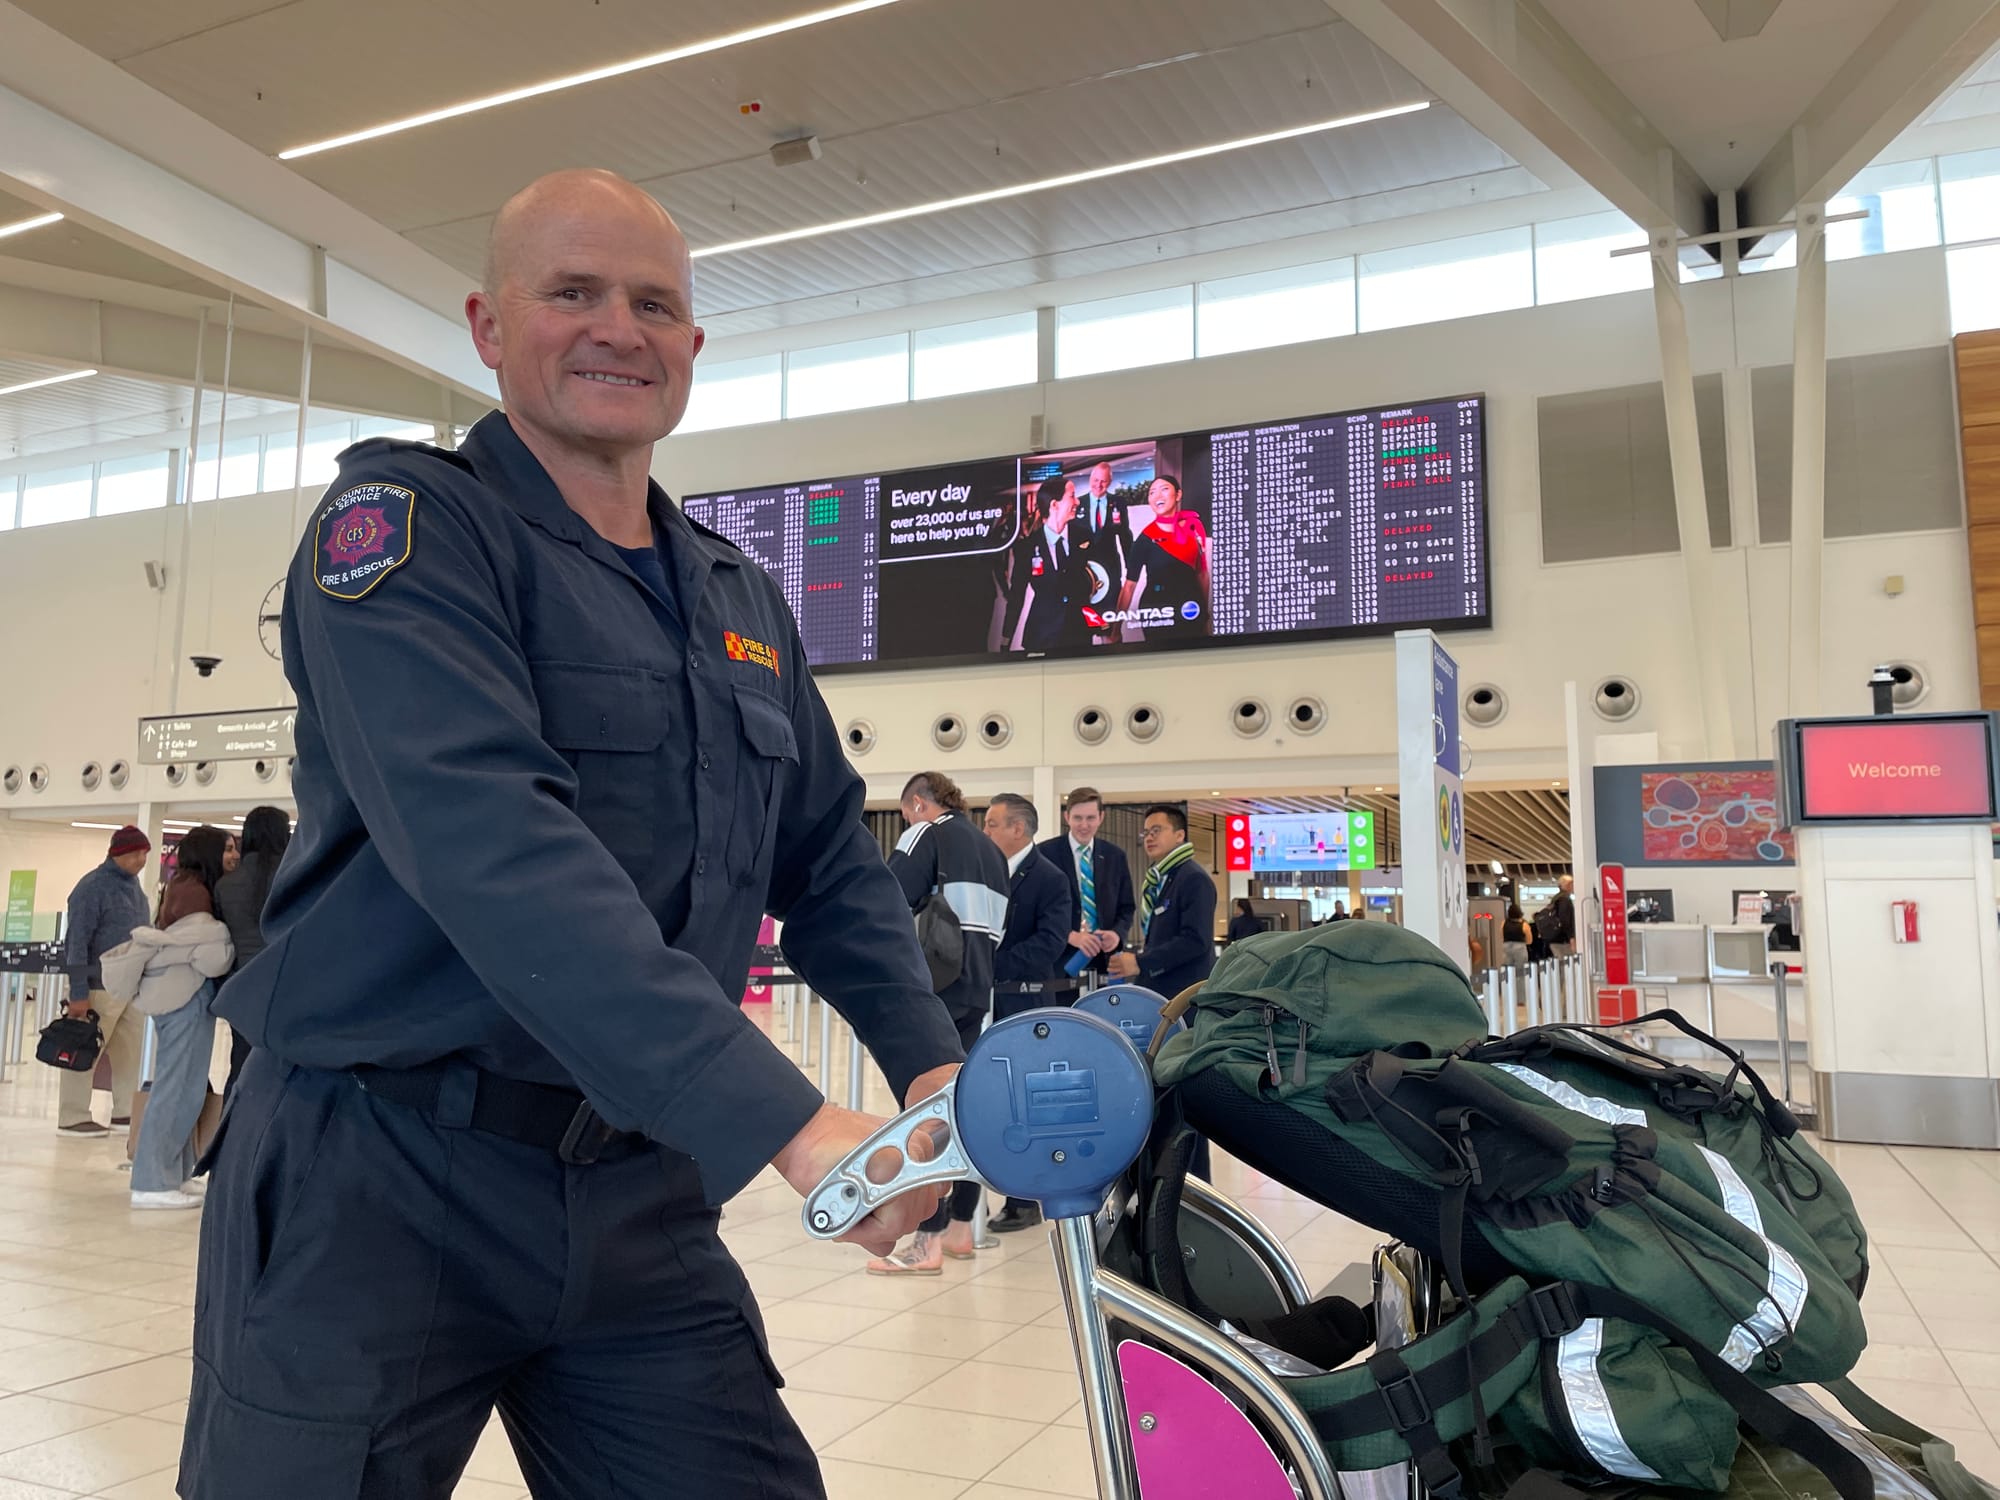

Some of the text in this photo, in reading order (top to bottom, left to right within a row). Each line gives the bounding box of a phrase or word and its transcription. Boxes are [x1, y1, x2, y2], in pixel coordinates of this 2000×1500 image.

[1380, 409, 1413, 419] REMARK
[1457, 400, 1478, 409] GATE
[1256, 435, 1281, 445] PORT
[1288, 428, 1334, 440] LINCOLN
[1382, 415, 1430, 428] DELAYED
[1256, 439, 1308, 452] BRISBANE
[1382, 422, 1437, 436] DEPARTED
[1256, 446, 1314, 459] SINGAPORE
[1382, 430, 1438, 443] DEPARTED
[1256, 456, 1295, 467] SYDNEY
[1383, 438, 1438, 451] DEPARTED
[1256, 462, 1308, 474] BRISBANE
[1383, 445, 1438, 459] BOARDING
[1256, 471, 1295, 482] SYDNEY
[1383, 456, 1417, 467] FINAL
[1424, 452, 1452, 462] CALL
[1256, 476, 1315, 489] KINGSCOTE
[1383, 466, 1396, 474] GO
[1404, 464, 1417, 472] TO
[1424, 459, 1452, 469] GATE
[1257, 484, 1308, 497] BRISBANE
[1383, 474, 1396, 482] GO
[1404, 471, 1417, 480] TO
[1425, 467, 1452, 477] GATE
[335, 486, 383, 506] COUNTRY
[383, 486, 409, 500] FIRE
[891, 483, 972, 508] Every day
[1257, 494, 1289, 504] KUALA
[1296, 489, 1335, 500] LUMPUR
[1383, 479, 1417, 490] FINAL
[1425, 475, 1452, 485] CALL
[338, 492, 381, 511] SERVICE
[1257, 496, 1335, 512] CARRAPATEENA
[890, 508, 1002, 529] over 23,000 of us are
[1257, 506, 1315, 519] MELBOURNE
[1257, 516, 1289, 526] MOUNT
[1296, 511, 1342, 522] GAMBIER
[1257, 523, 1302, 534] OLYMPIC
[1309, 520, 1329, 528] DAM
[1384, 512, 1397, 521] GO
[1404, 510, 1418, 518] TO
[1425, 506, 1453, 516] GATE
[347, 527, 363, 541] CFS
[890, 523, 990, 544] here to help you fly
[1257, 532, 1283, 541] GOLD
[1289, 528, 1322, 538] COAST
[1257, 538, 1296, 549] BROKEN
[1303, 535, 1329, 544] HILL
[1384, 524, 1432, 536] DELAYED
[1257, 546, 1296, 556] SYDNEY
[1257, 553, 1296, 564] MOOMBA
[1384, 544, 1398, 552] GO
[1405, 541, 1418, 550] TO
[1426, 538, 1454, 547] GATE
[322, 556, 395, 586] FIRE & RESCUE
[1257, 560, 1309, 571] BRISBANE
[1257, 568, 1303, 579] OLYMPIC
[1310, 565, 1329, 574] DAM
[1385, 559, 1398, 567] GO
[1405, 557, 1419, 565] TO
[1426, 554, 1454, 563] GATE
[1258, 575, 1309, 586] CANBERRA
[1258, 585, 1283, 594] PORT
[1290, 580, 1336, 591] LINCOLN
[1385, 571, 1433, 583] DELAYED
[1258, 587, 1336, 601] MAROOCHYDORE
[1258, 597, 1316, 609] MELBOURNE
[1101, 606, 1175, 622] QANTAS
[1258, 605, 1310, 616] BRISBANE
[1258, 612, 1317, 624] MELBOURNE
[1258, 621, 1297, 631] SYDNEY
[742, 638, 765, 655] FIRE
[747, 651, 774, 670] RESCUE
[1848, 761, 1941, 779] Welcome
